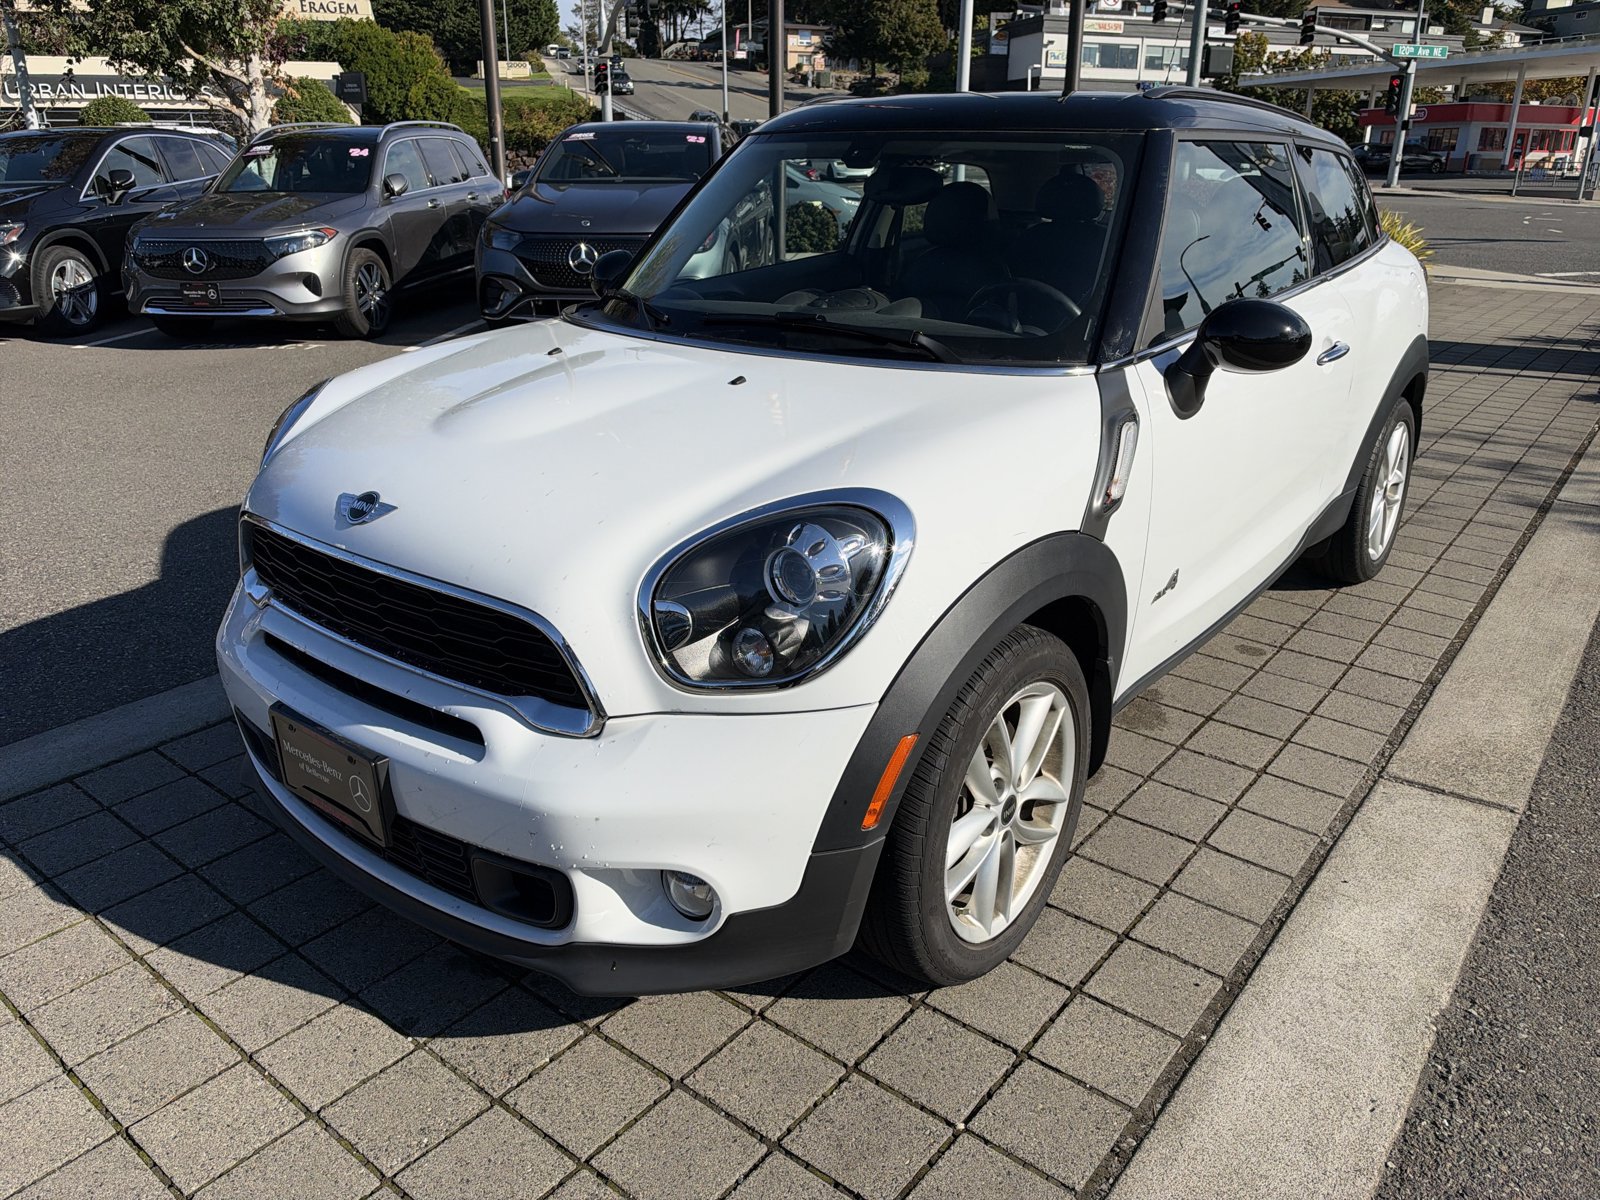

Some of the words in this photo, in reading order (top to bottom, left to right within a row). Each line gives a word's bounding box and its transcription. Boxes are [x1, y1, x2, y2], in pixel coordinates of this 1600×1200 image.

[1399, 45, 1415, 55] 120th
[1417, 46, 1430, 56] Ave
[1433, 47, 1442, 57] NE
[351, 500, 374, 513] MINI
[282, 739, 343, 782] Mercedes-Benz
